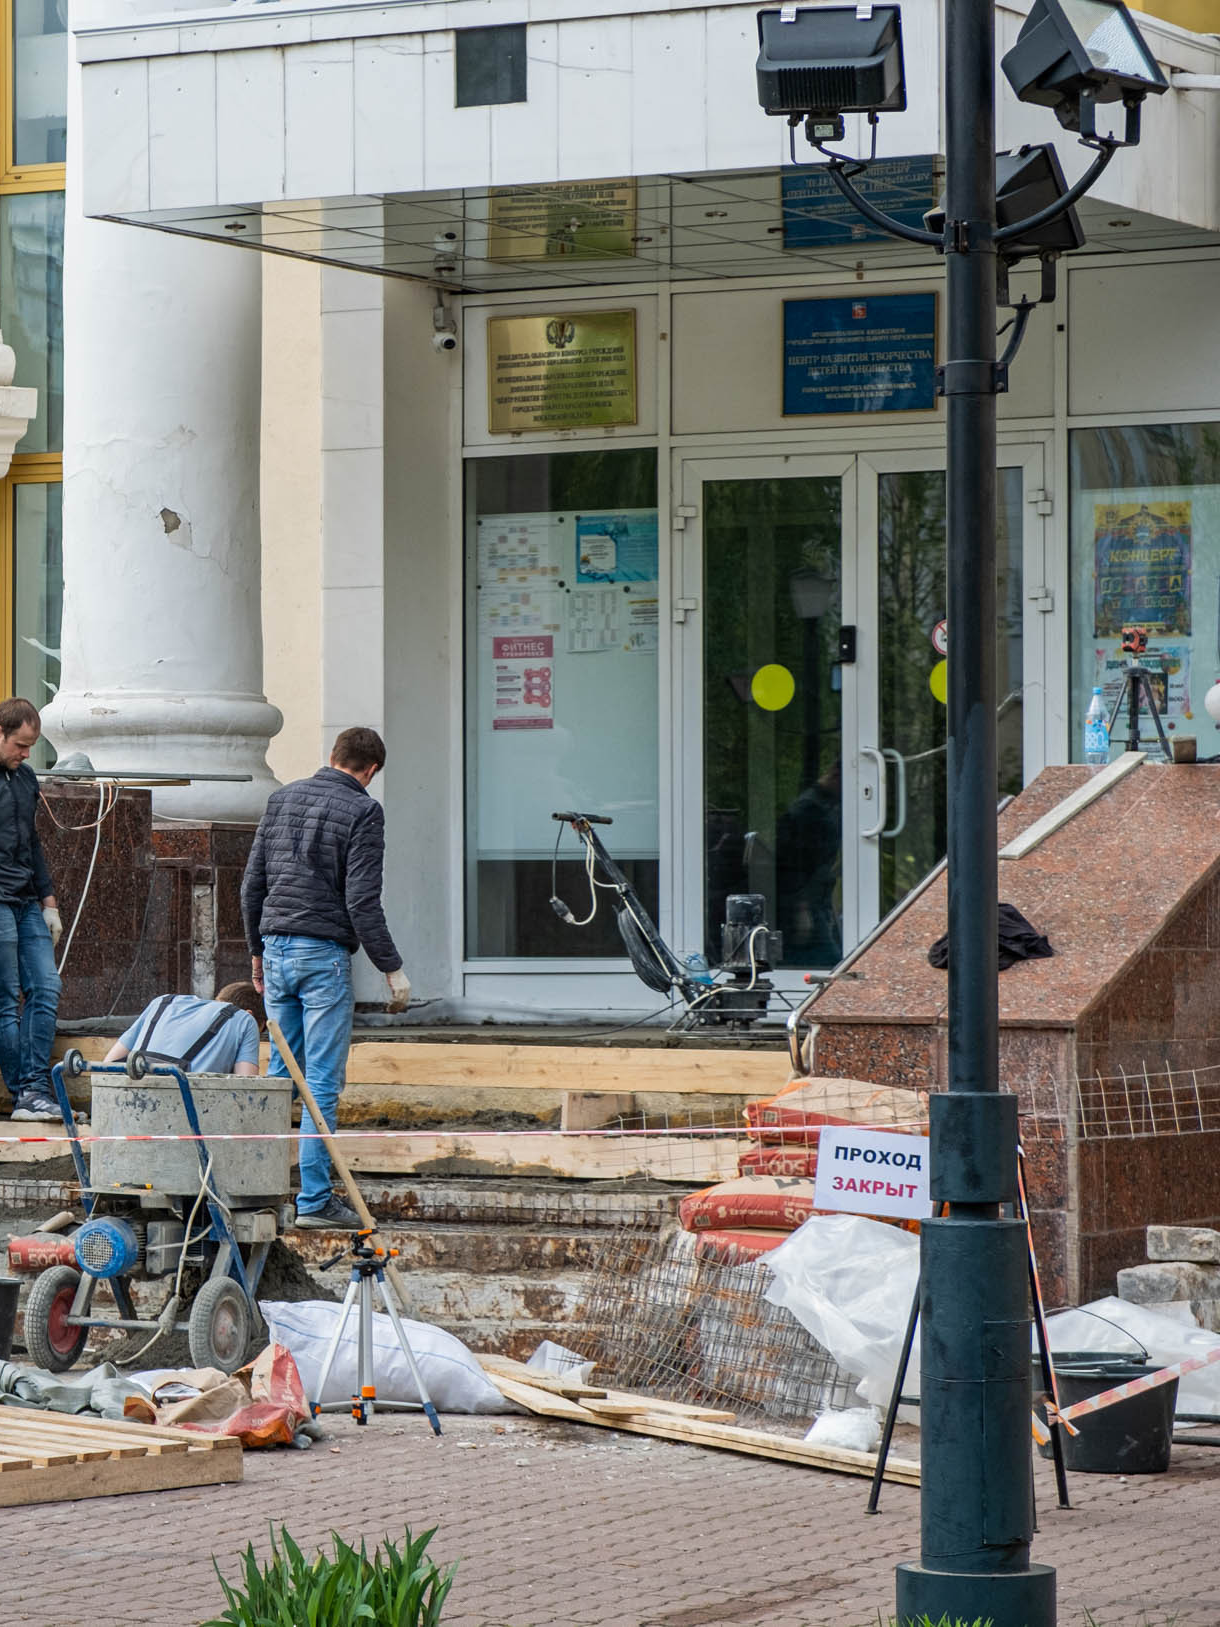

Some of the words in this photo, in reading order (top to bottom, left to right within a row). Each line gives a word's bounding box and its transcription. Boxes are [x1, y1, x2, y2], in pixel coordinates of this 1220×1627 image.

[788, 355, 820, 366] ЦЕНТР
[821, 353, 869, 363] РАЗВИТИЯ
[870, 350, 932, 361] ТВОРЧЕСТВА
[849, 362, 911, 373] ЮНОШЕСТВА
[1110, 549, 1180, 562] КОНЦЕРТ
[501, 642, 545, 652] ФИТНЕС
[835, 1146, 921, 1171] ПРОХОД
[832, 1177, 918, 1198] ЗАКРЫТ
